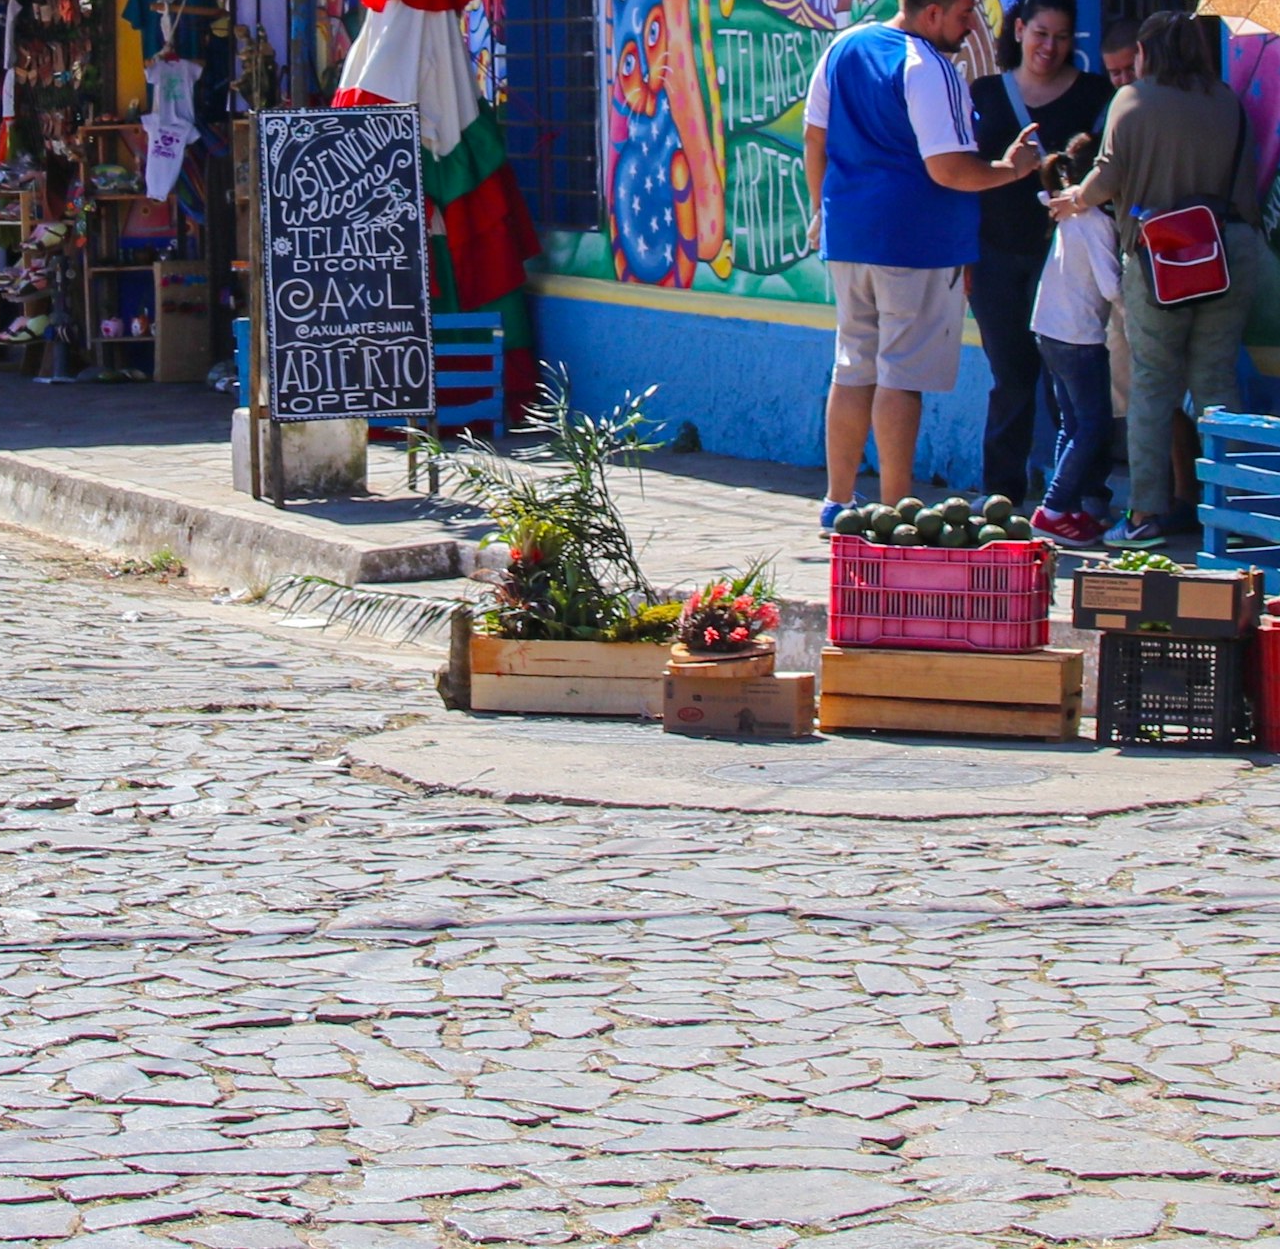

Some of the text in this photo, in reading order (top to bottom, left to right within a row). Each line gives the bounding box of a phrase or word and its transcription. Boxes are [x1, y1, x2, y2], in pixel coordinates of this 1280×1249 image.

[718, 29, 807, 130] TELARES
[293, 113, 413, 201] BIENVENIDOS
[280, 149, 413, 226] welcome
[287, 223, 406, 259] TELARES
[293, 255, 411, 272] DICONTE
[295, 321, 415, 339] @AXULARTESANIA
[279, 345, 426, 394] ABIERTO
